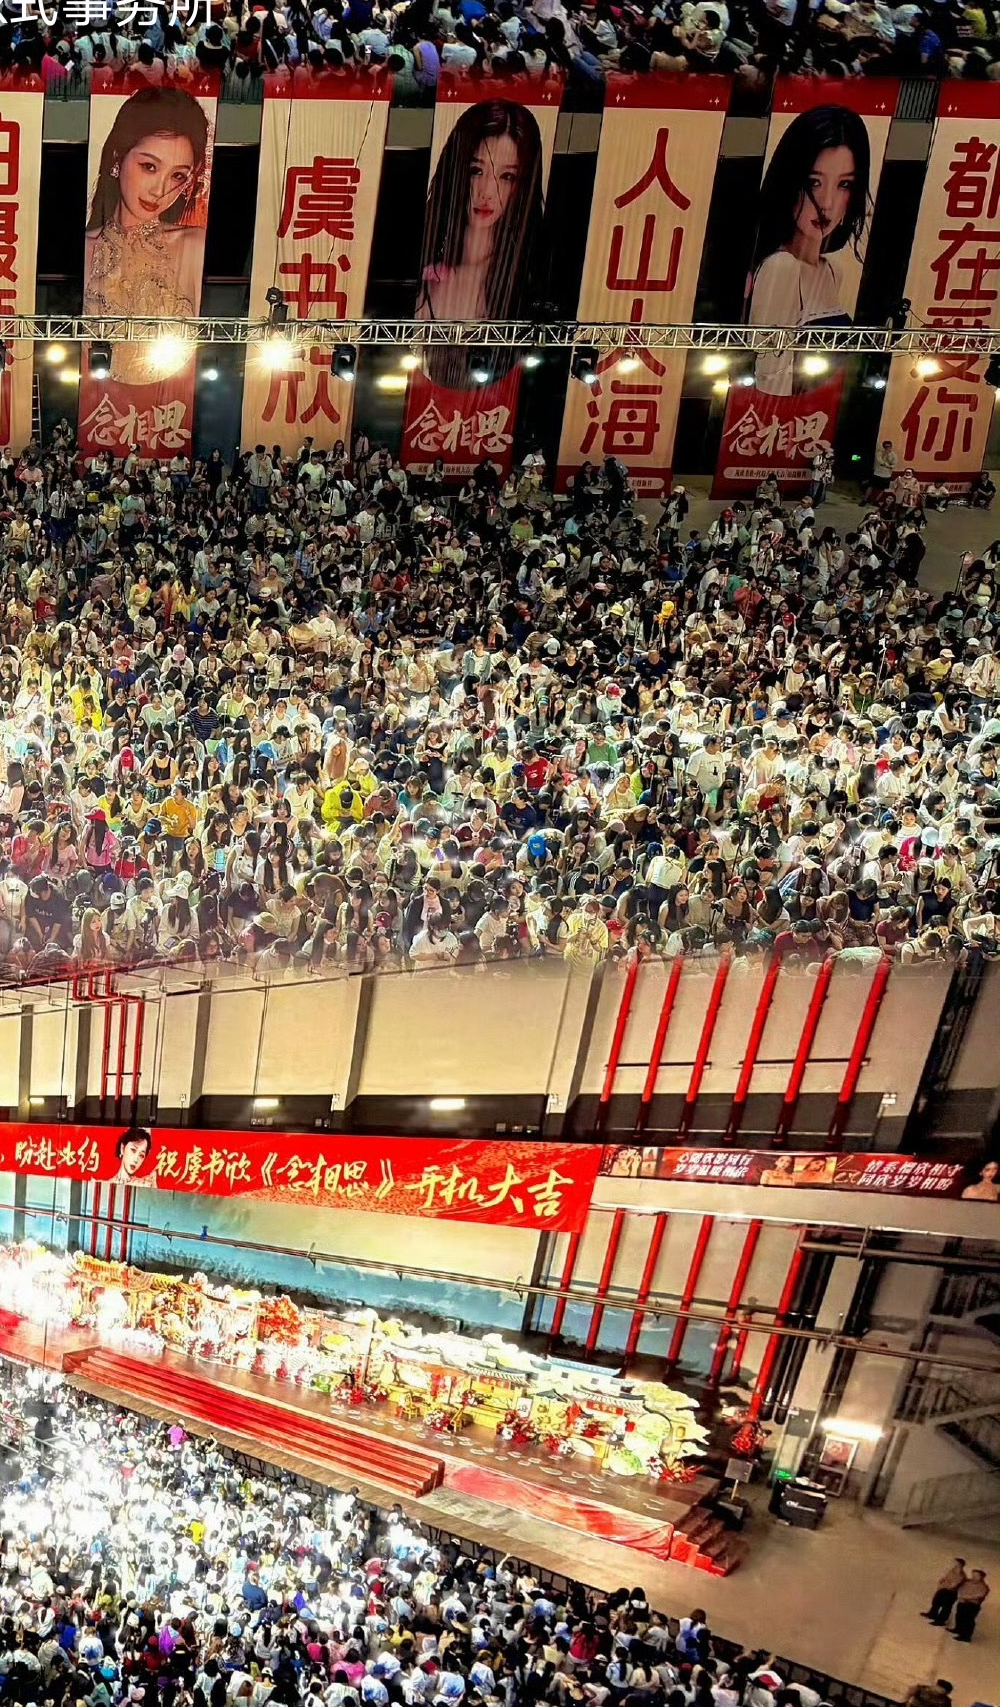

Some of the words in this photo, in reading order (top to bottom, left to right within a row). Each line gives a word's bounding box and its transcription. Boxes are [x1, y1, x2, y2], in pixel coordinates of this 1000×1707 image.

[80, 393, 192, 450] 念相思
[405, 399, 513, 456] 念相思
[723, 403, 833, 459] 念相思
